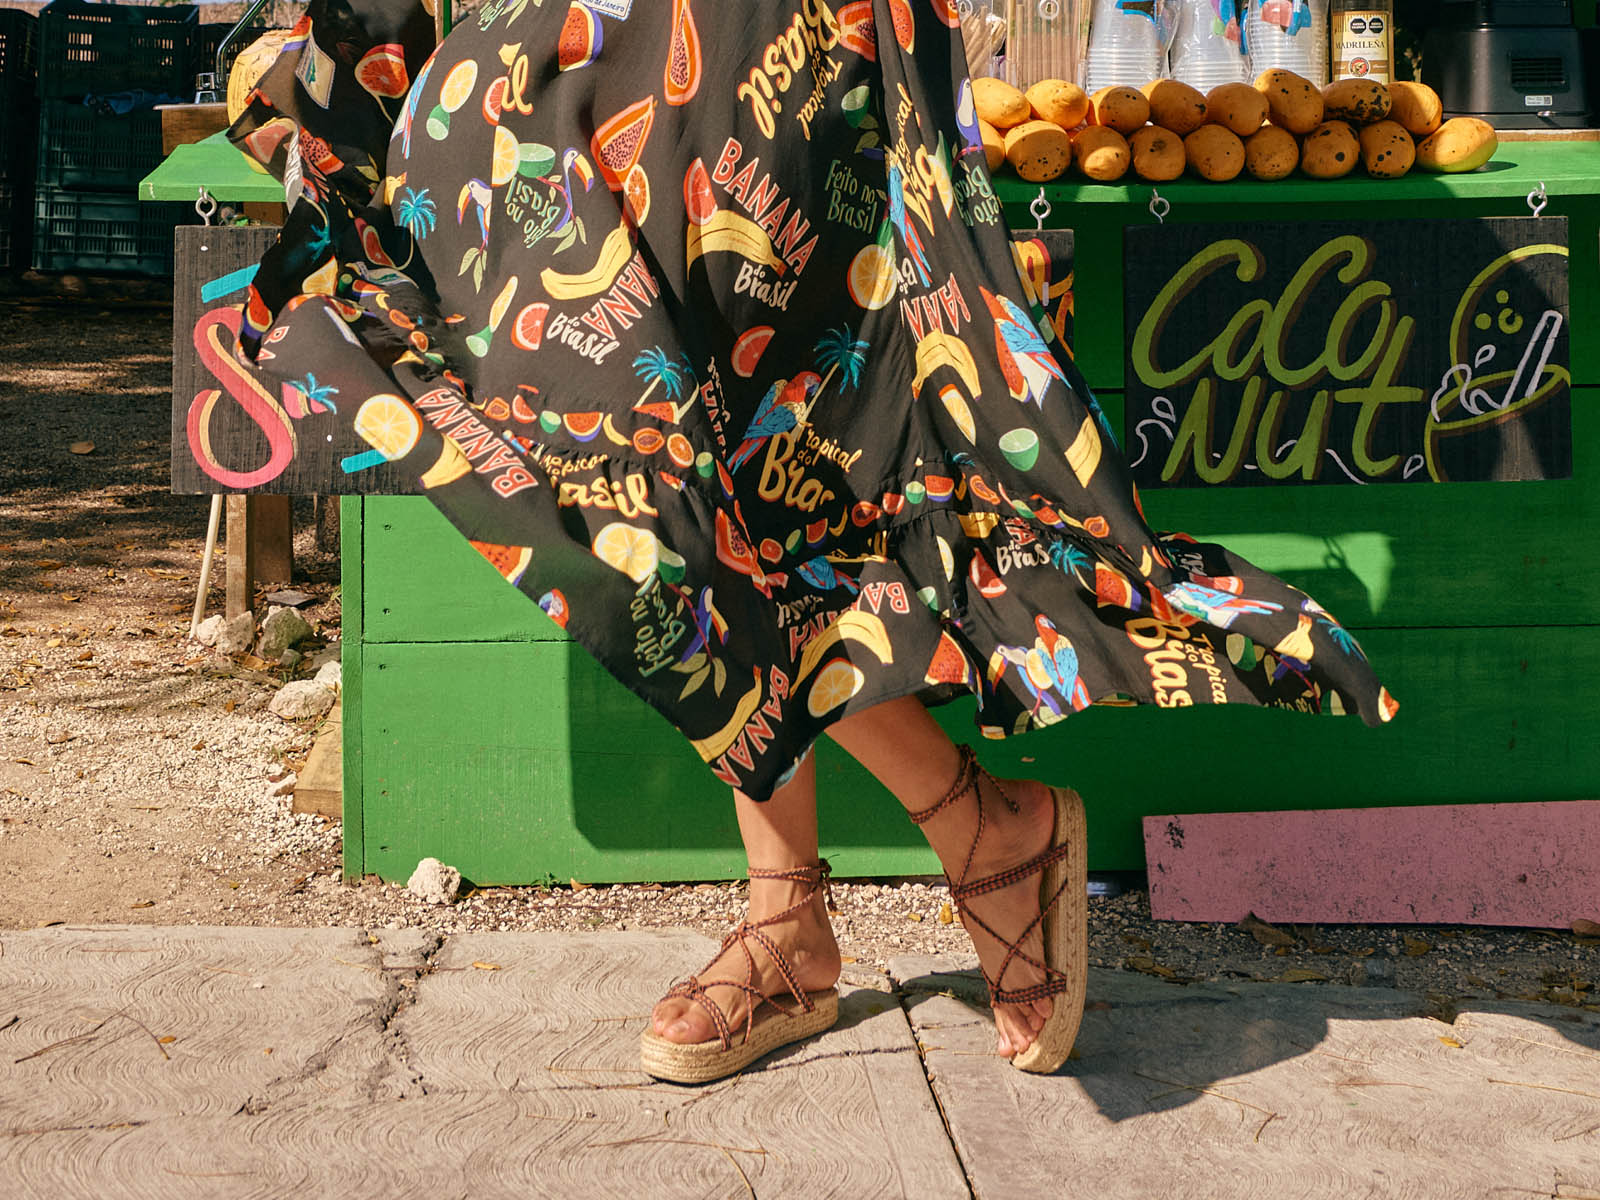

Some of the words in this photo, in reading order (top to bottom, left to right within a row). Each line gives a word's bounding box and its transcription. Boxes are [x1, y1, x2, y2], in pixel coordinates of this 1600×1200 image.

[1335, 39, 1386, 49] MADRILEÑA
[796, 54, 844, 141] Tropical
[504, 176, 561, 231] Brasil
[711, 136, 820, 277] BANANA
[824, 159, 858, 196] Feito
[861, 187, 877, 205] no
[826, 189, 878, 234] Brasil
[733, 260, 799, 312] Brasil
[752, 265, 766, 279] do
[546, 312, 620, 366] Brasil
[566, 315, 580, 328] do
[413, 387, 540, 498] BANANA
[798, 420, 863, 474] Tropical
[1008, 540, 1021, 551] do
[633, 623, 675, 678] Feito
